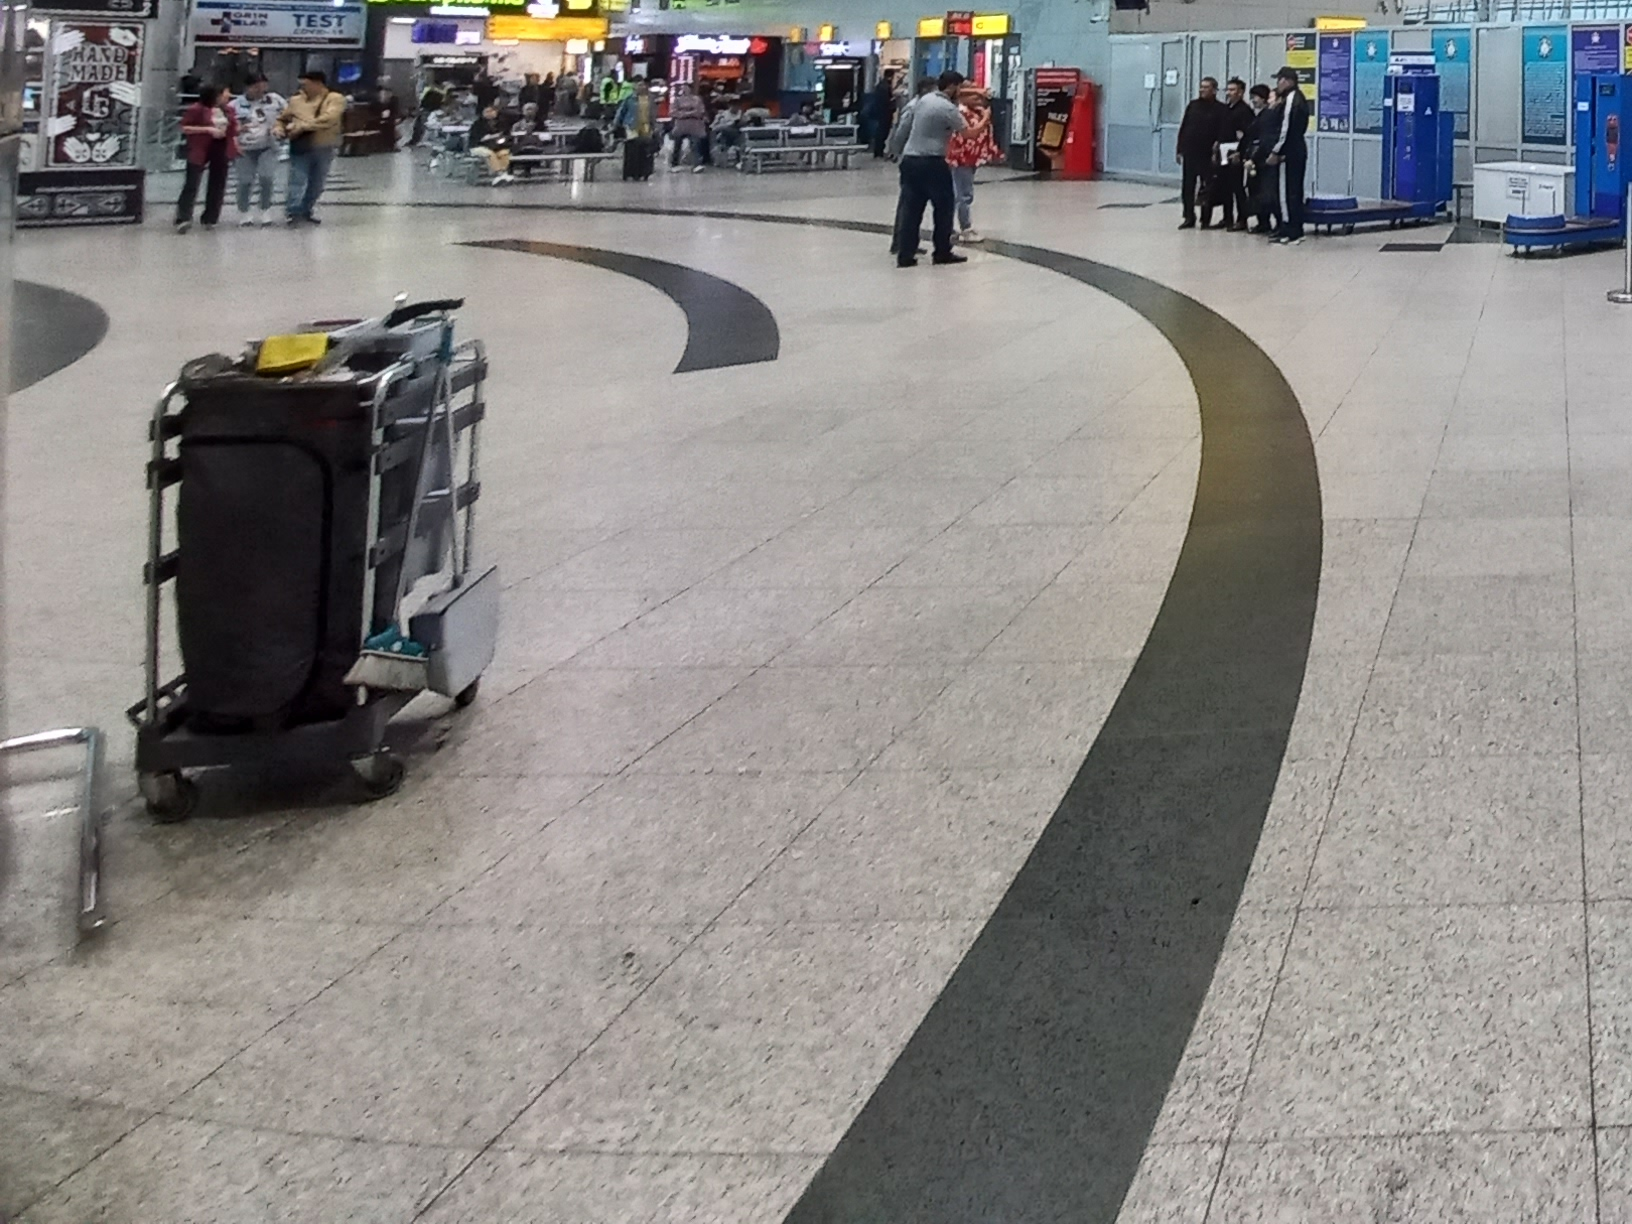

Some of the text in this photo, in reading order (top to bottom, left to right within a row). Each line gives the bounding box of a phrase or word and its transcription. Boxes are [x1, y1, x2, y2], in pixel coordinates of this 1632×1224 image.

[292, 13, 346, 27] TEST
[72, 44, 129, 65] HAND
[69, 63, 129, 82] MADE
